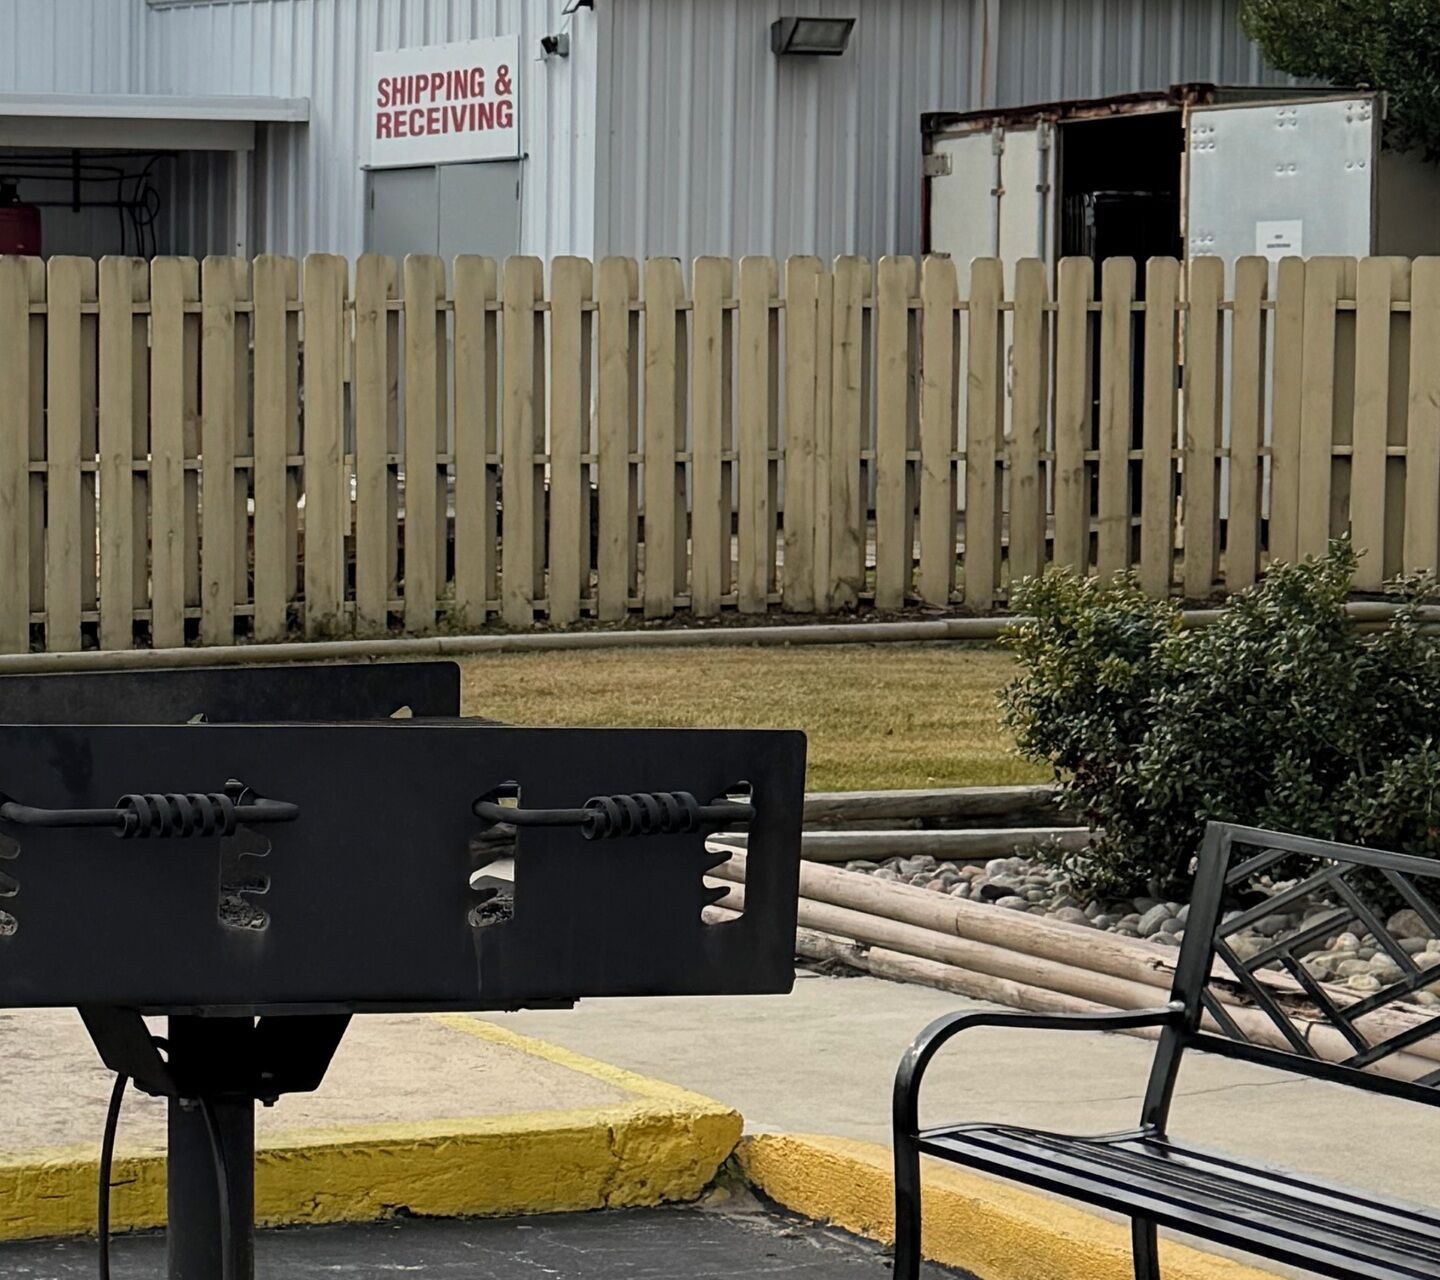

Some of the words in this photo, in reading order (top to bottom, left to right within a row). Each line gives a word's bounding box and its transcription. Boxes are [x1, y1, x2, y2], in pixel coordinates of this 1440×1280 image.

[376, 67, 485, 108] SHIPPING
[494, 64, 513, 96] &
[376, 99, 513, 139] RECEIVING
